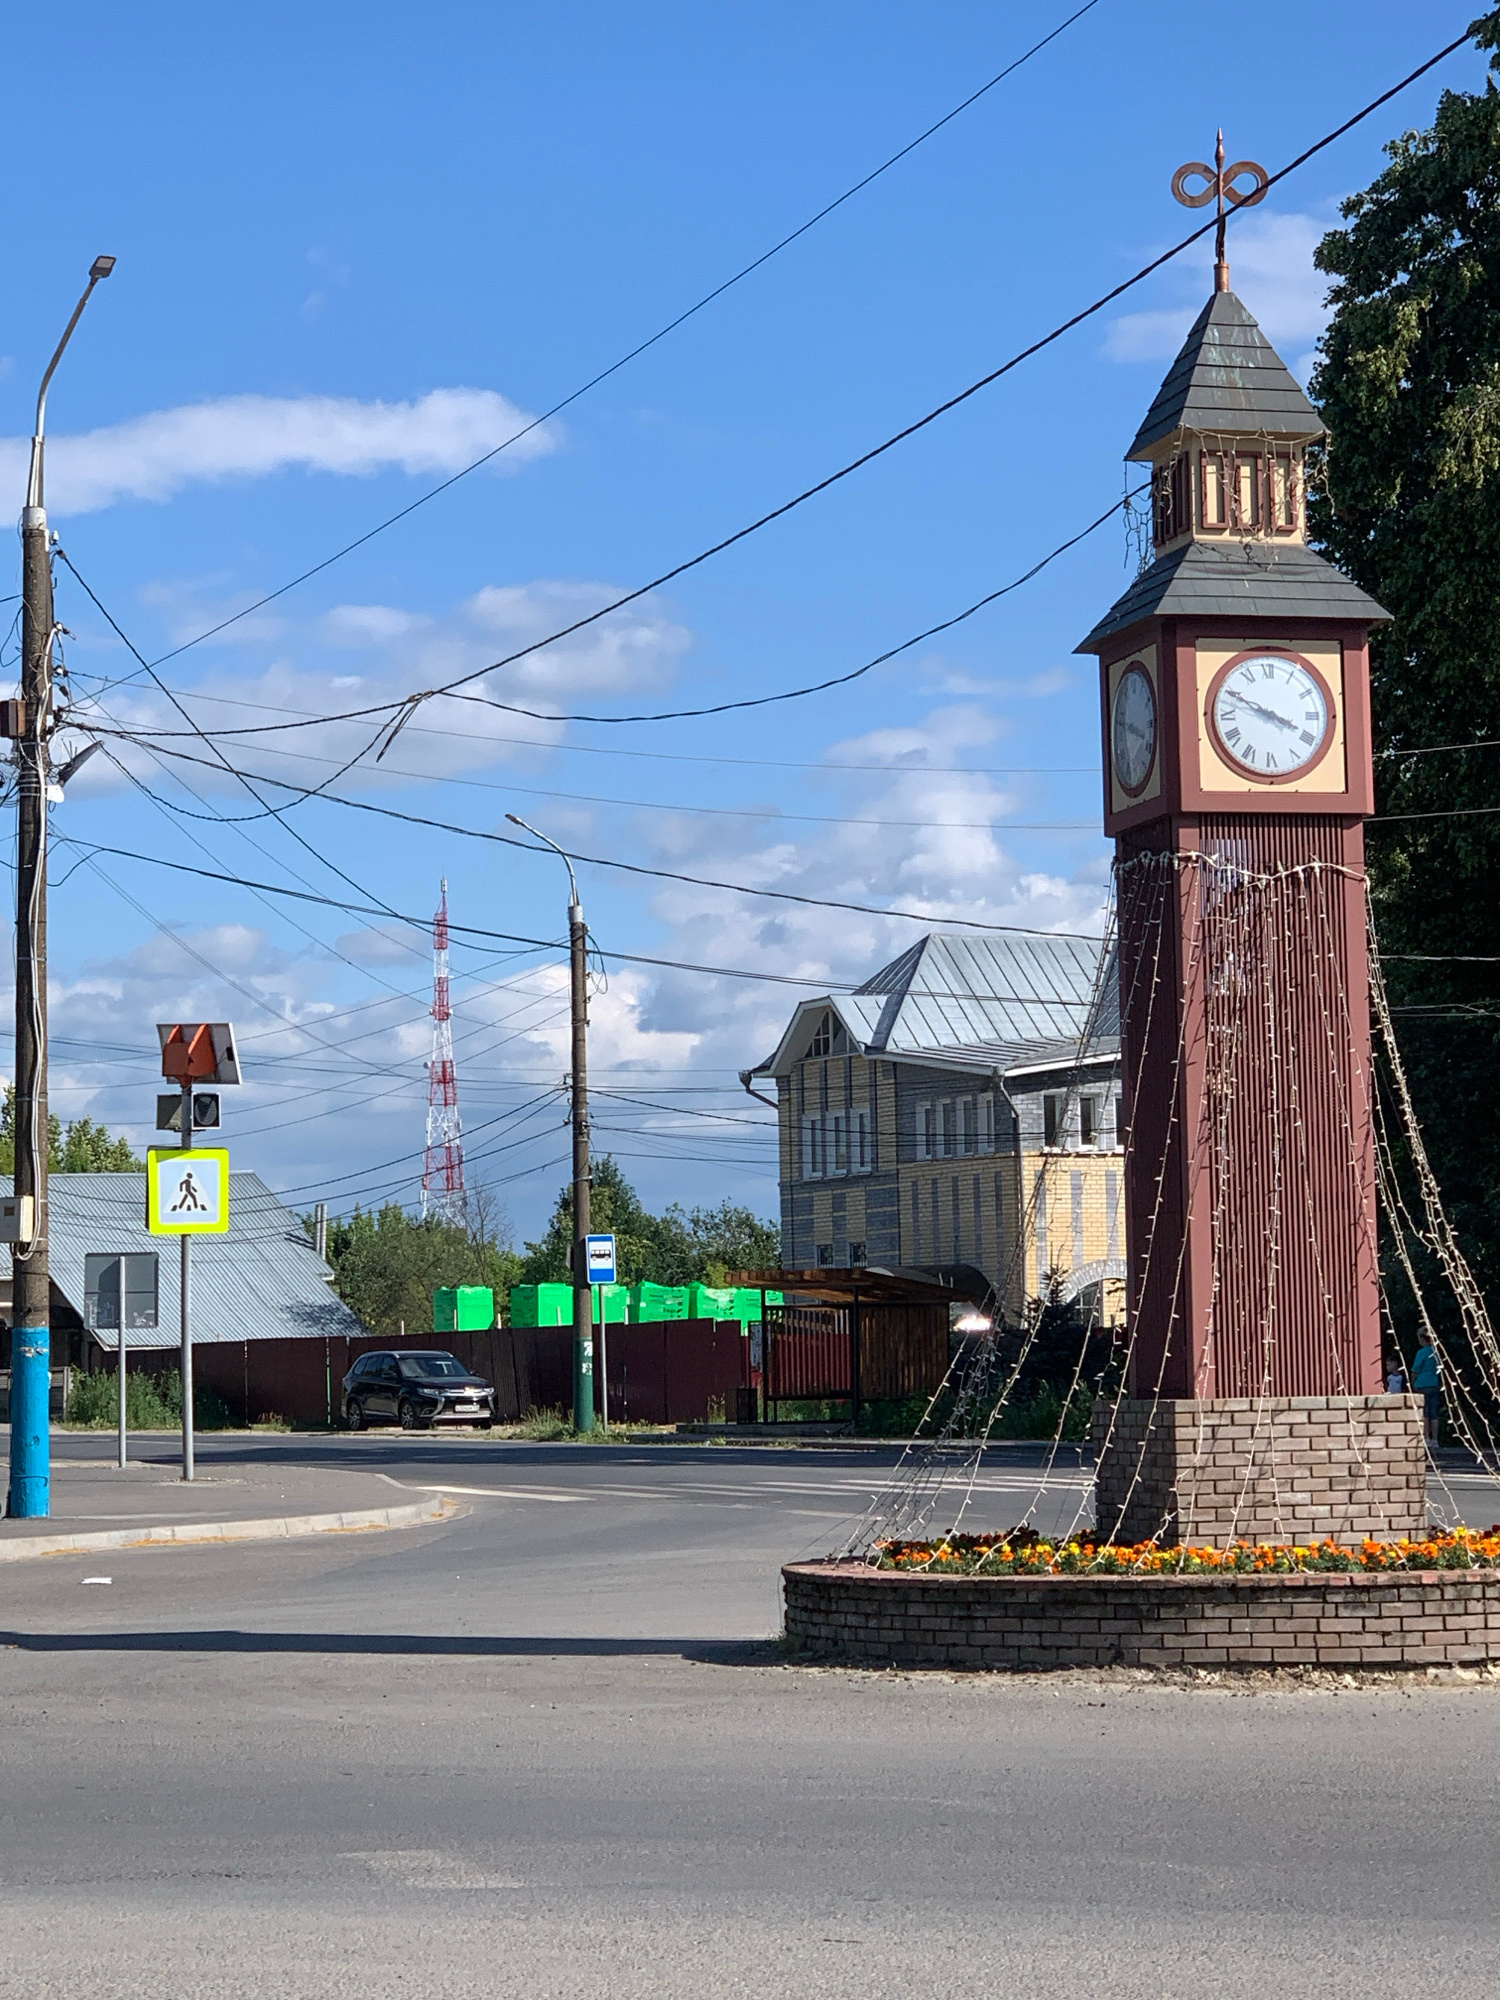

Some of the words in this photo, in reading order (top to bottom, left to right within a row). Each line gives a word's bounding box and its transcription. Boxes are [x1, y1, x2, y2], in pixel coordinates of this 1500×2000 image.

[1240, 667, 1256, 686] XI
[1260, 664, 1274, 679] XII
[1286, 670, 1294, 684] I
[1299, 688, 1313, 699] II
[1221, 708, 1236, 720] IX
[1305, 711, 1319, 720] III
[1224, 727, 1241, 748] VIII
[1299, 729, 1316, 747] IIII
[1241, 744, 1256, 764] VII
[1266, 751, 1278, 768] VI
[1289, 748, 1301, 763] V
